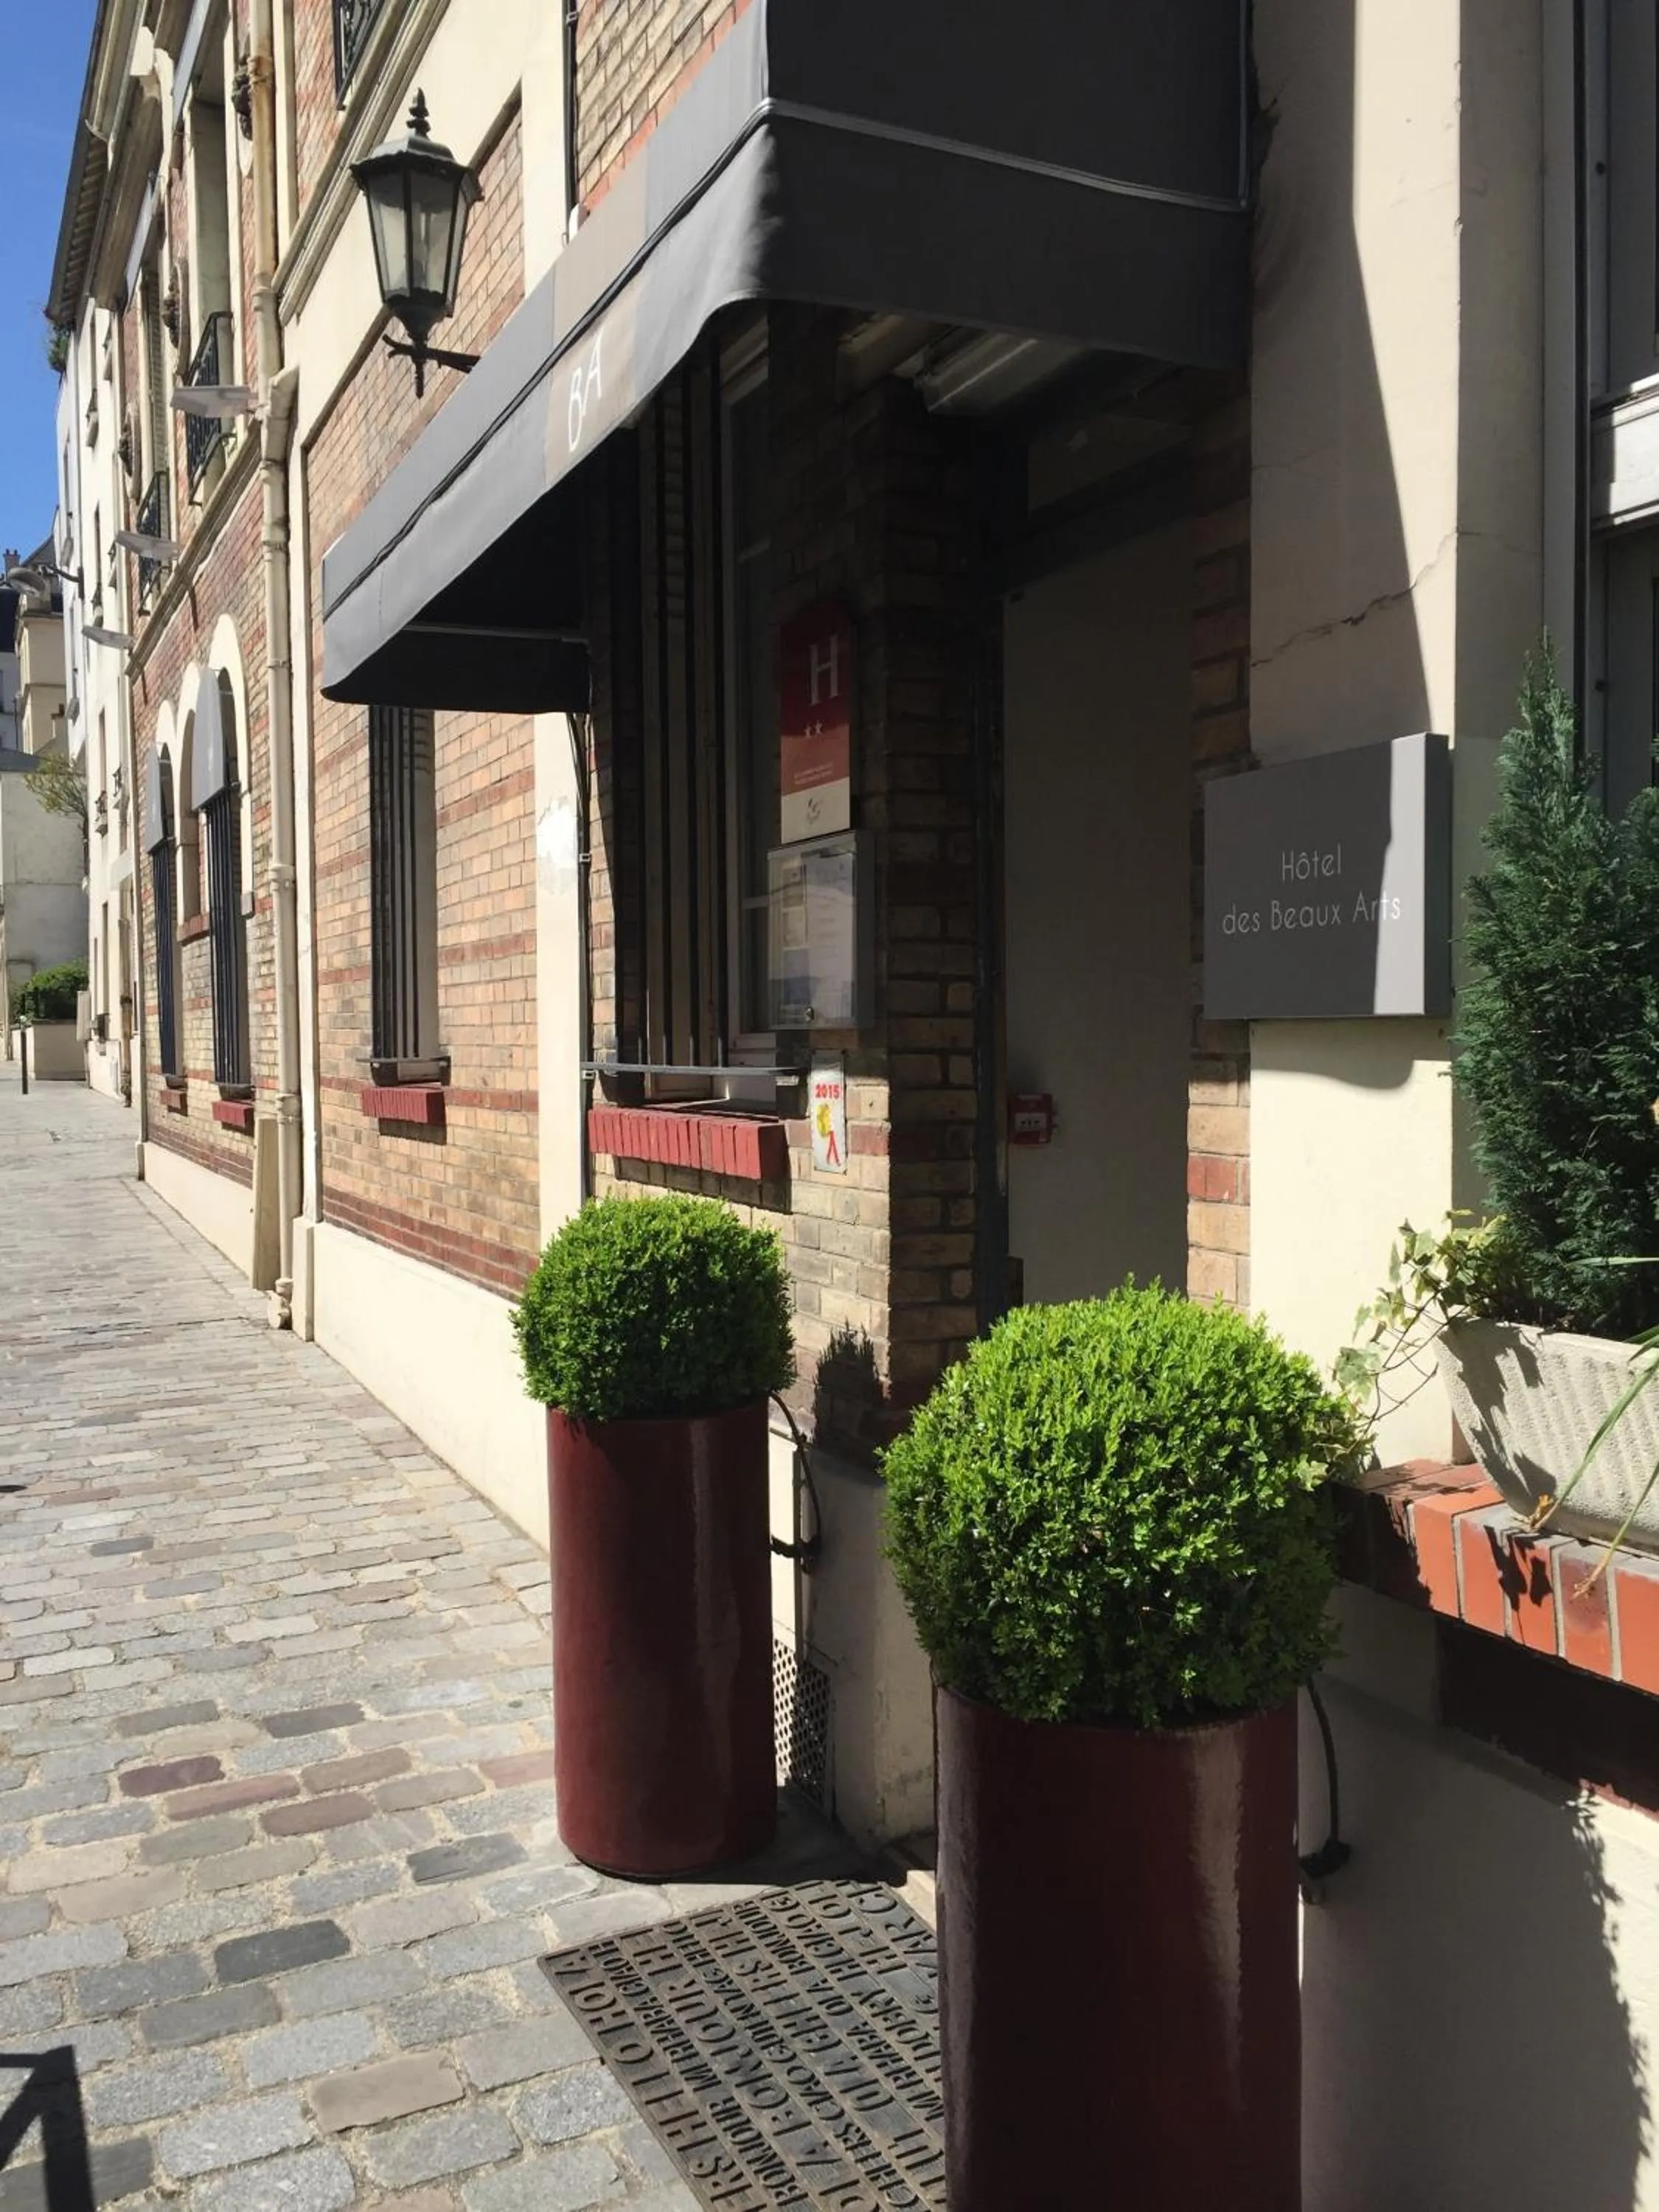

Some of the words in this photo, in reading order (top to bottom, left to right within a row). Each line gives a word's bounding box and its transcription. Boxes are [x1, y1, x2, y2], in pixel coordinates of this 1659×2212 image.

[568, 323, 603, 452] BA
[810, 634, 838, 706] H
[1281, 844, 1343, 882] Hôtel
[1222, 902, 1261, 935] des
[1270, 900, 1341, 931] Beaux
[1352, 889, 1402, 922] Arts
[815, 1084, 841, 1099] 2015
[702, 2094, 811, 2209] BONJOUR
